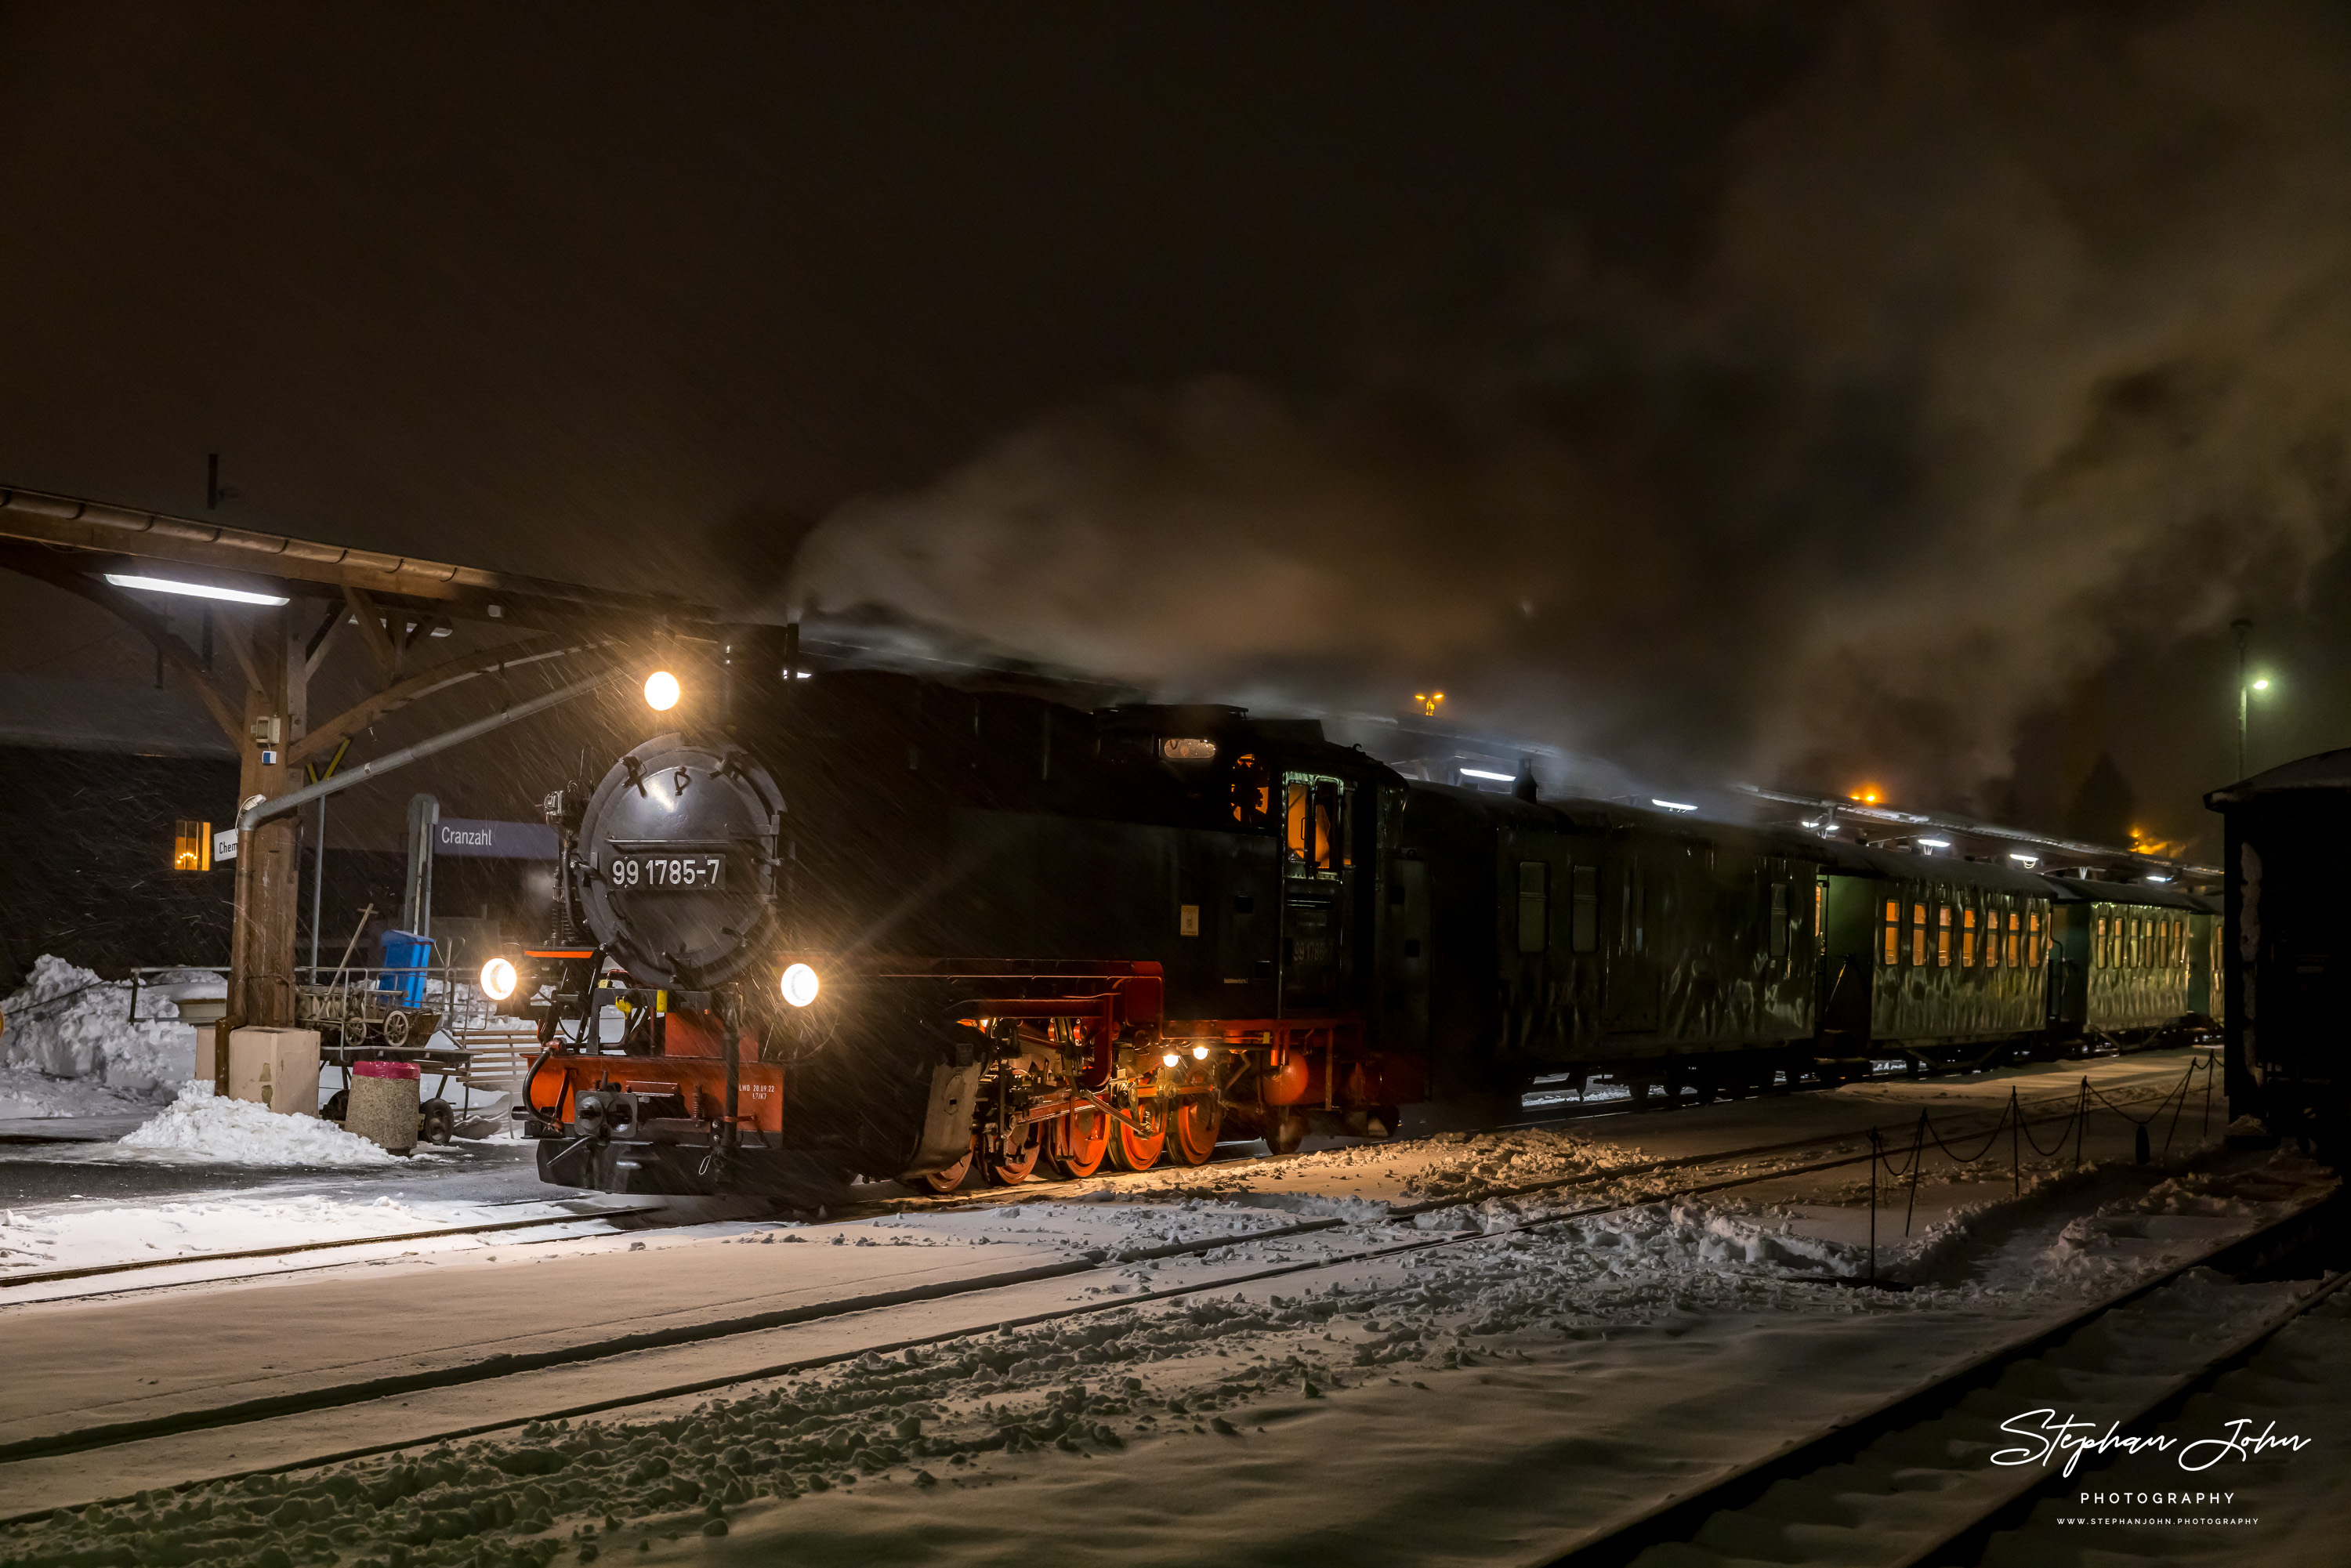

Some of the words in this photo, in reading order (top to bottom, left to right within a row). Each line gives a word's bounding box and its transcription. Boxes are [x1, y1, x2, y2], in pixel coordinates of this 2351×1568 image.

[441, 826, 492, 846] Cranzahl
[613, 860, 639, 885] 99
[645, 859, 720, 885] 1785-7
[1293, 941, 1305, 961] 99
[752, 1085, 775, 1093] 28.09.22
